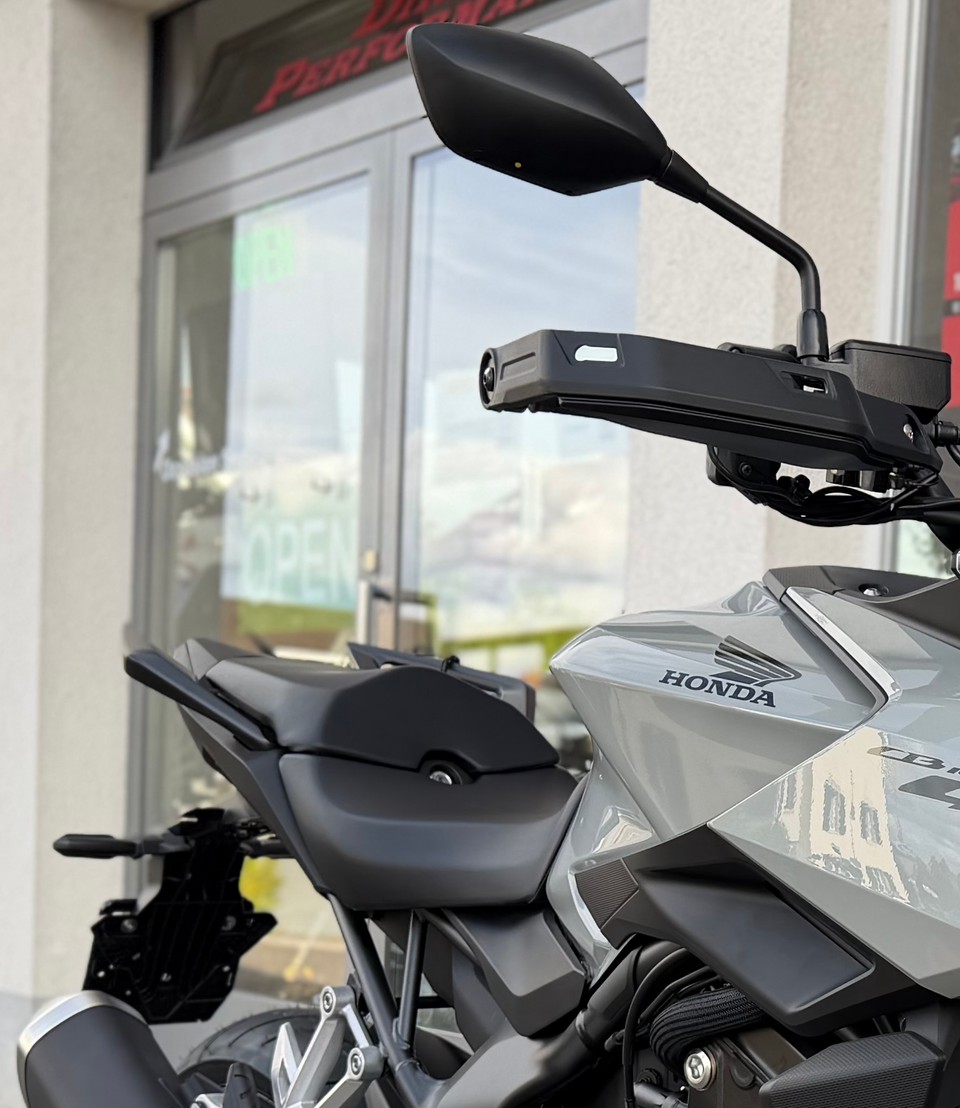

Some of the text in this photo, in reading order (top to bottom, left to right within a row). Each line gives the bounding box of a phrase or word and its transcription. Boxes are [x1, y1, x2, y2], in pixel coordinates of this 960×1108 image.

[244, 515, 357, 600] OPEN
[659, 669, 776, 708] HONDA
[867, 746, 945, 770] CB
